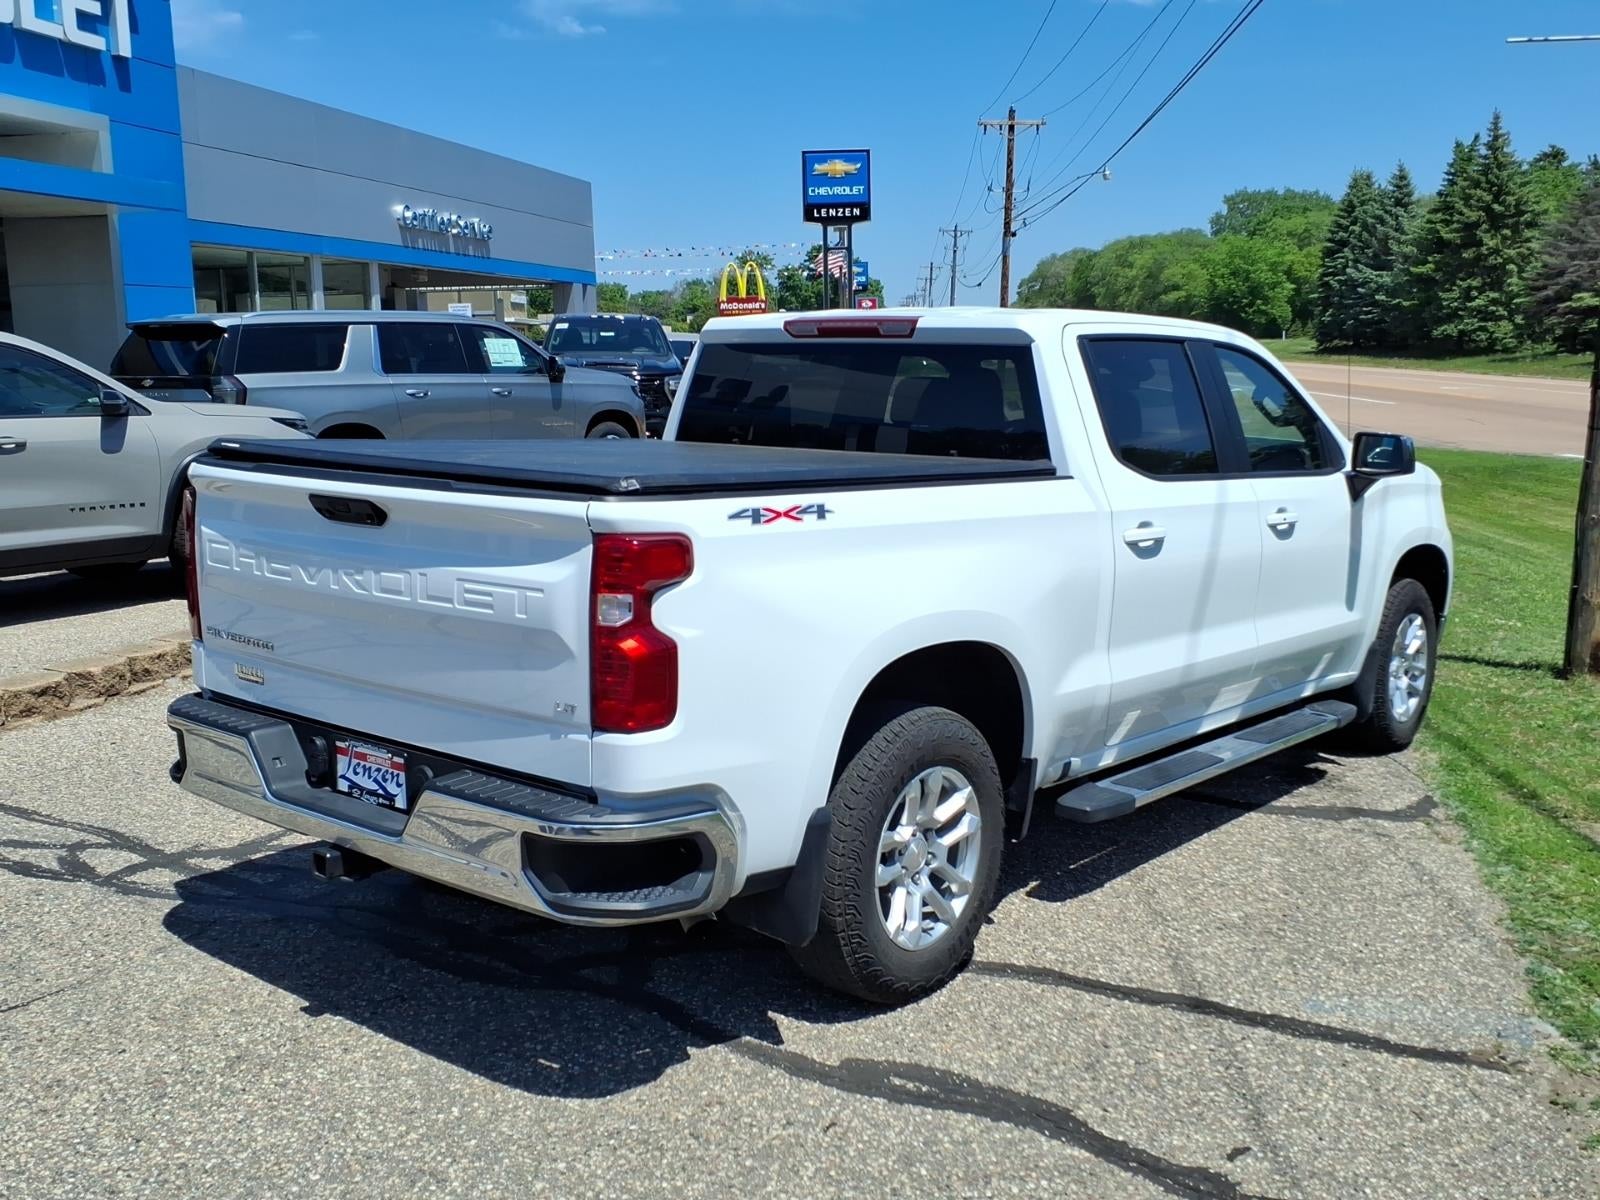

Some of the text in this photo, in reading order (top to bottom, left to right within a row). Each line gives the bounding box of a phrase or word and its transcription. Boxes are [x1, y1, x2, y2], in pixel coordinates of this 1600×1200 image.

[808, 186, 864, 196] CHEVROLET
[813, 208, 860, 217] LENZEN
[402, 204, 494, 241] Certified Service
[720, 302, 765, 311] McDonald's
[68, 502, 146, 513] TRAVERSE
[205, 537, 545, 618] CHEVROLET
[339, 741, 404, 797] Lenzen
